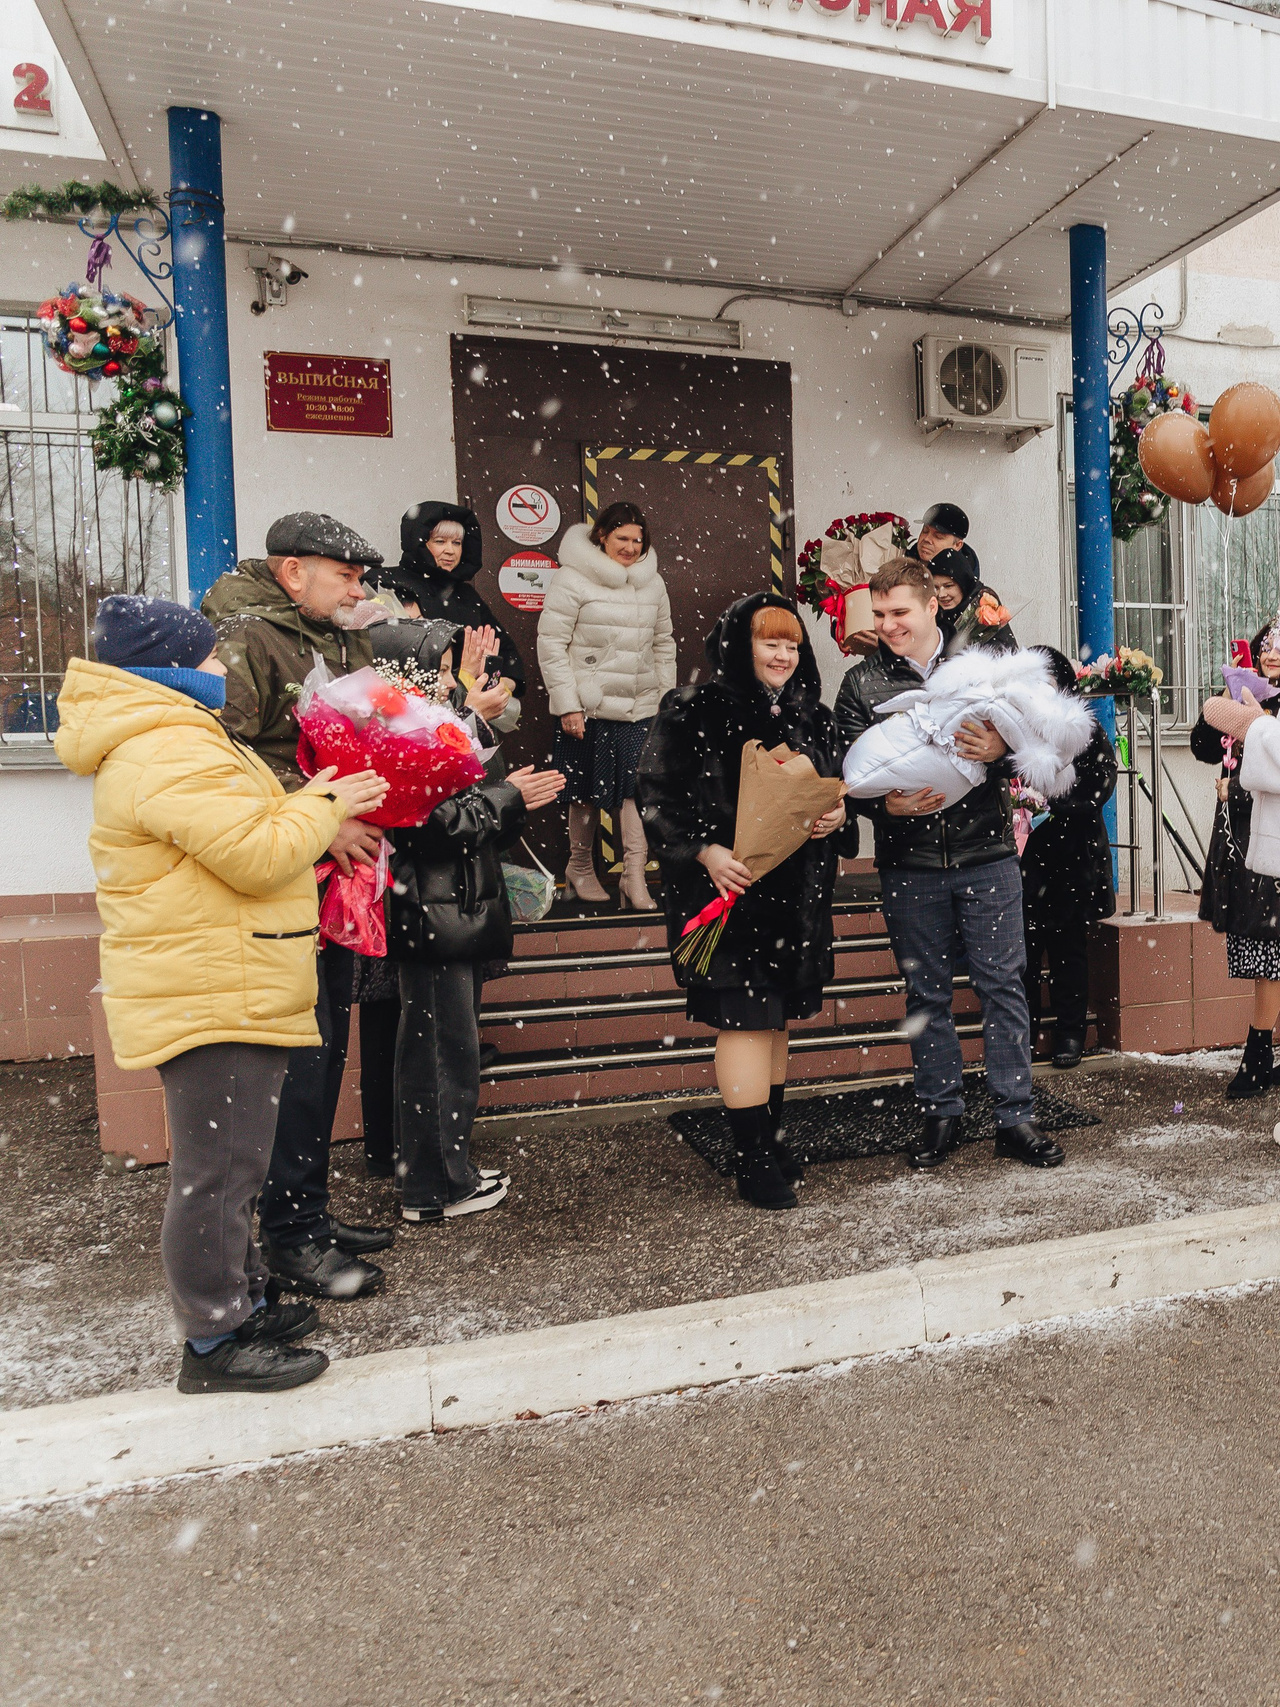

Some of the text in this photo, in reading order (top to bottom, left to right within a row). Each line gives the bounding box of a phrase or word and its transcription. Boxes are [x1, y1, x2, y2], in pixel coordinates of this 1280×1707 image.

[12, 62, 52, 115] 2
[277, 371, 379, 389] ВЫПИСНАЯ
[296, 393, 328, 403] Режим
[305, 403, 328, 412] 10:30
[305, 413, 355, 422] ежедневно
[510, 559, 552, 568] ВНИМАНИЕ!
